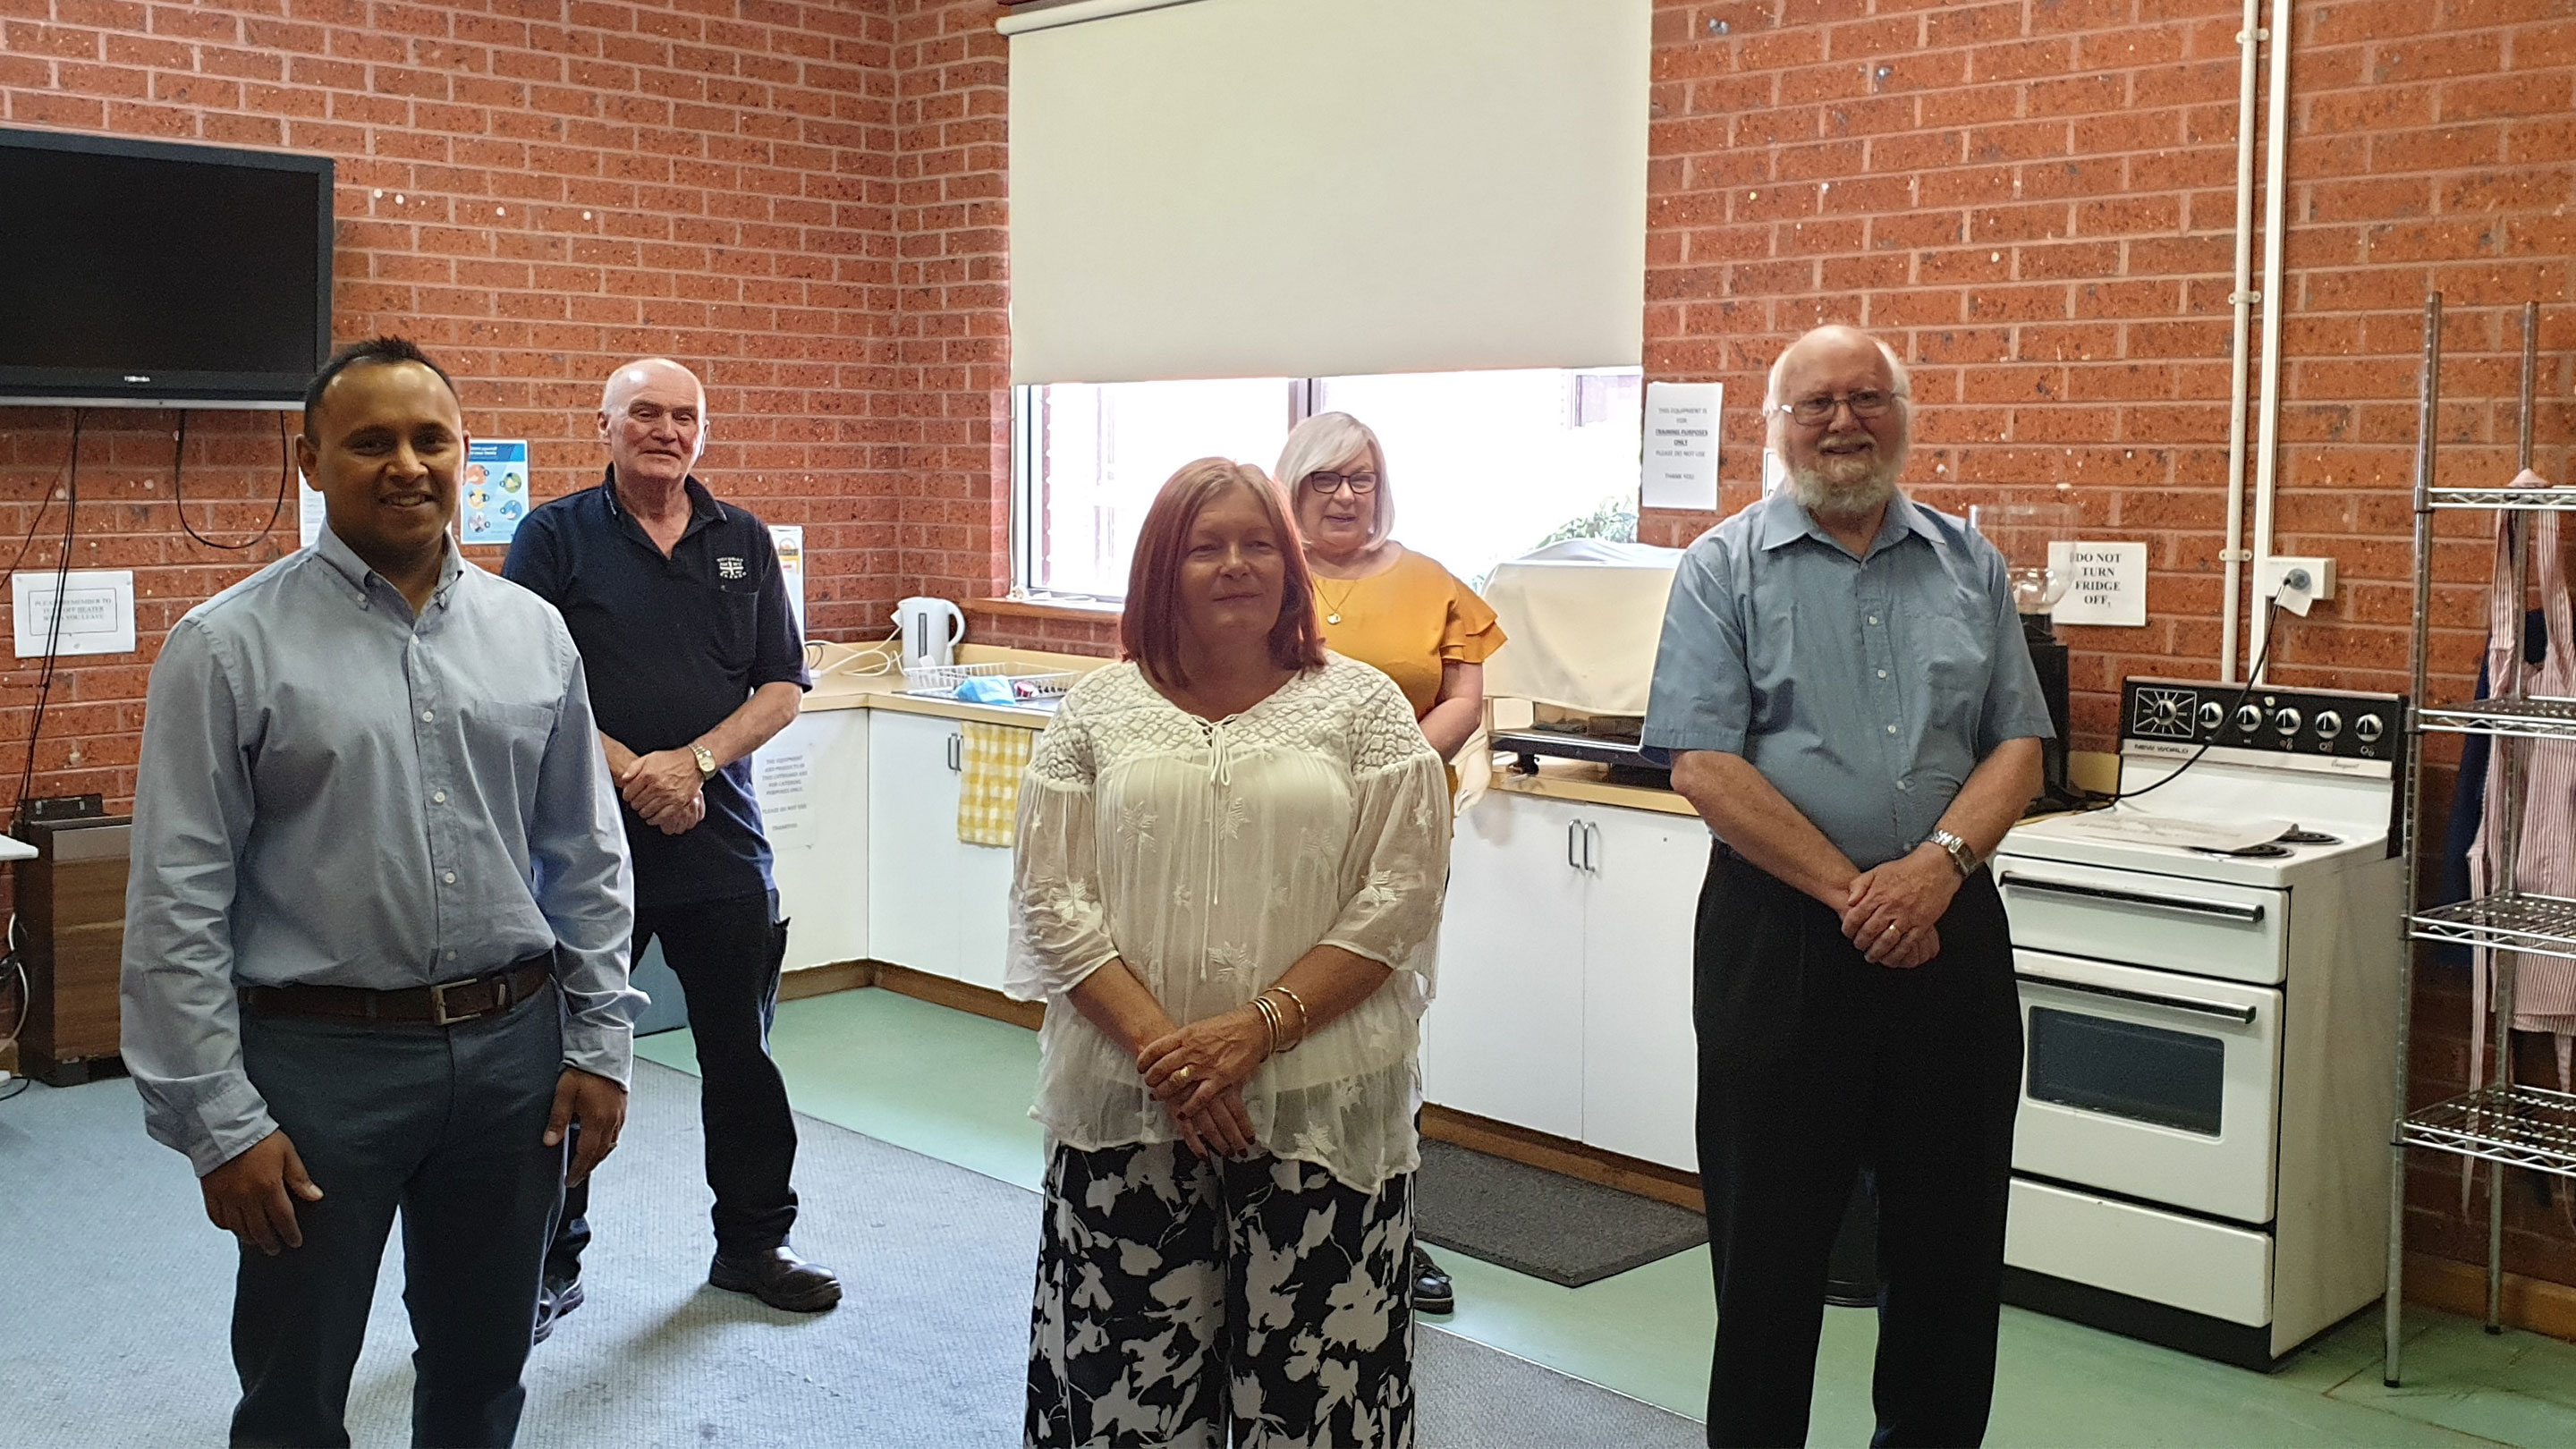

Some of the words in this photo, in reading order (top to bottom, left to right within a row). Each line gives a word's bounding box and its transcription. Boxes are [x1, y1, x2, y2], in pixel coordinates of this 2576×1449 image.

[1655, 428, 1680, 436] TRAINING
[2075, 553, 2093, 564] DO
[2097, 553, 2122, 564] NOT
[2082, 567, 2114, 577] TURN
[2075, 581, 2121, 591] FRIDGE
[2134, 743, 2156, 751] NEW
[2157, 746, 2189, 754] WORLD
